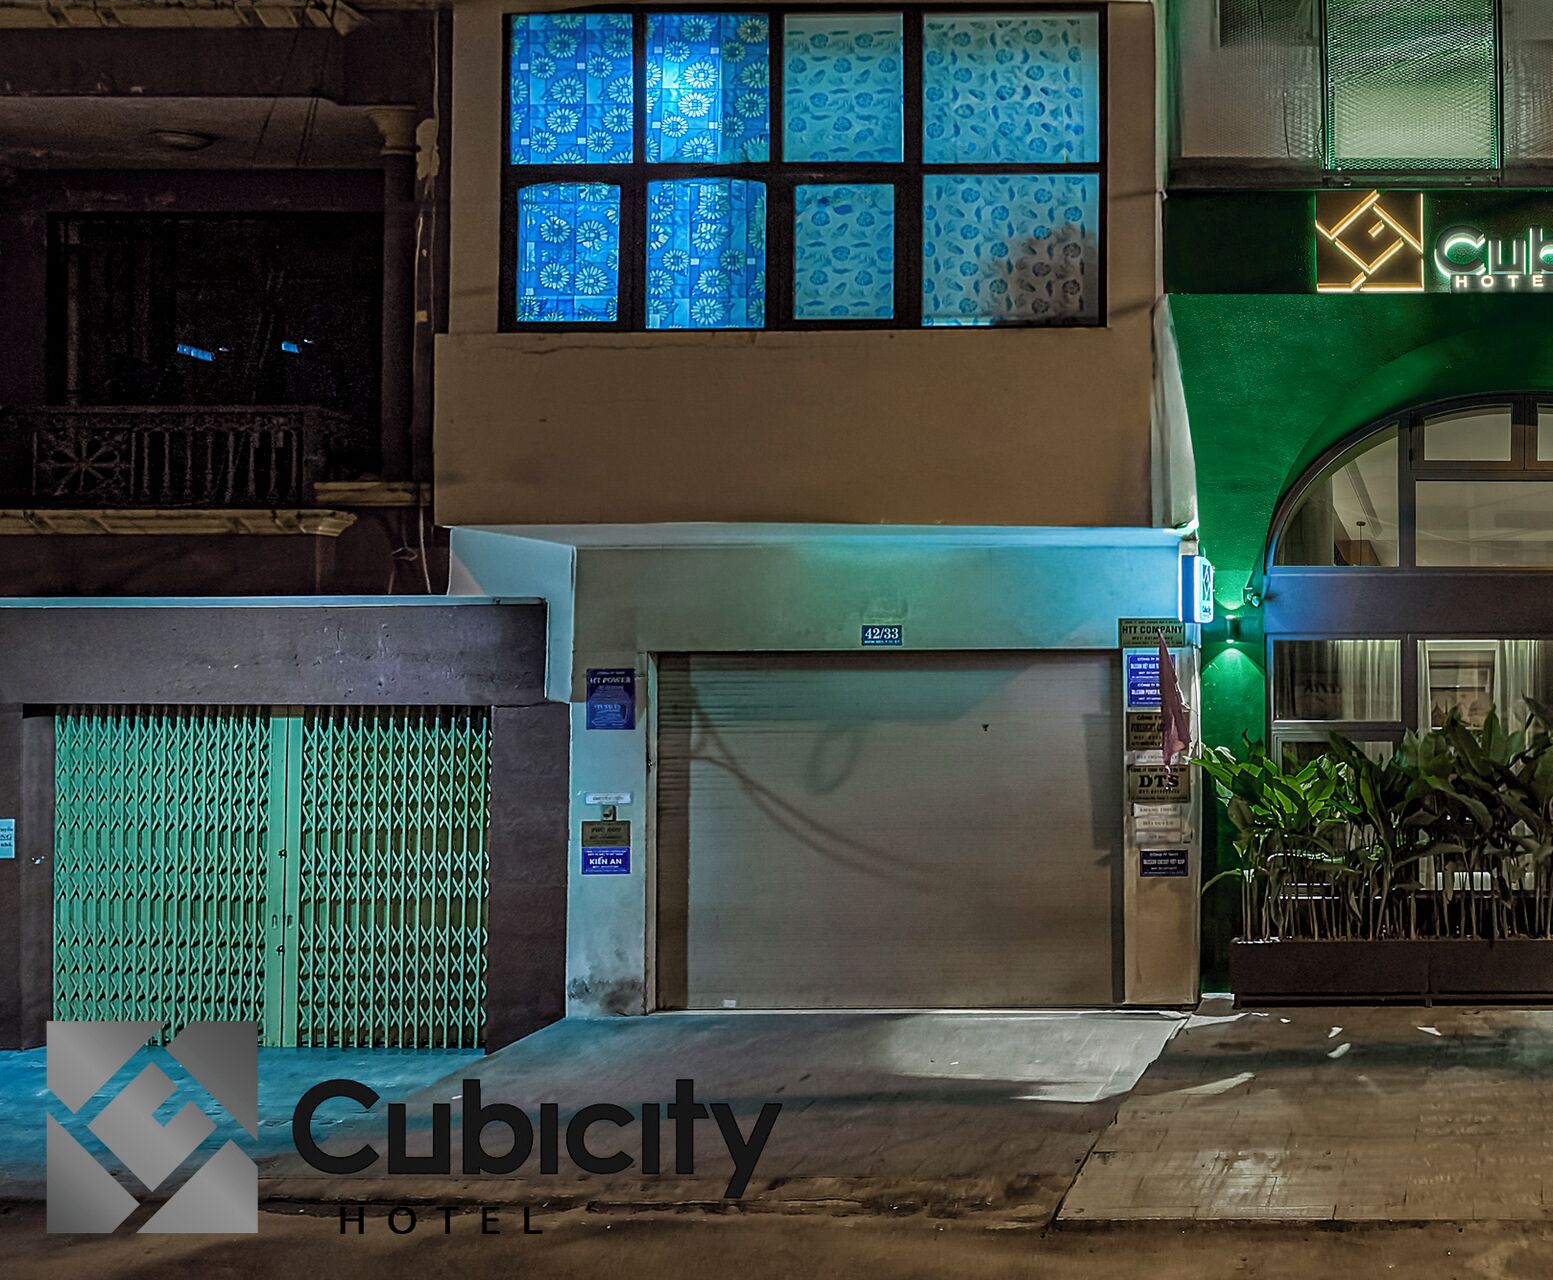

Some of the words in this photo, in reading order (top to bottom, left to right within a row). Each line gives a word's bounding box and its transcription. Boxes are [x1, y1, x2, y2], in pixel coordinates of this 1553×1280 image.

[864, 627, 899, 640] 42/33
[1122, 625, 1138, 634] HTT
[1140, 625, 1183, 634] COMPANY
[1138, 774, 1180, 788] DTS
